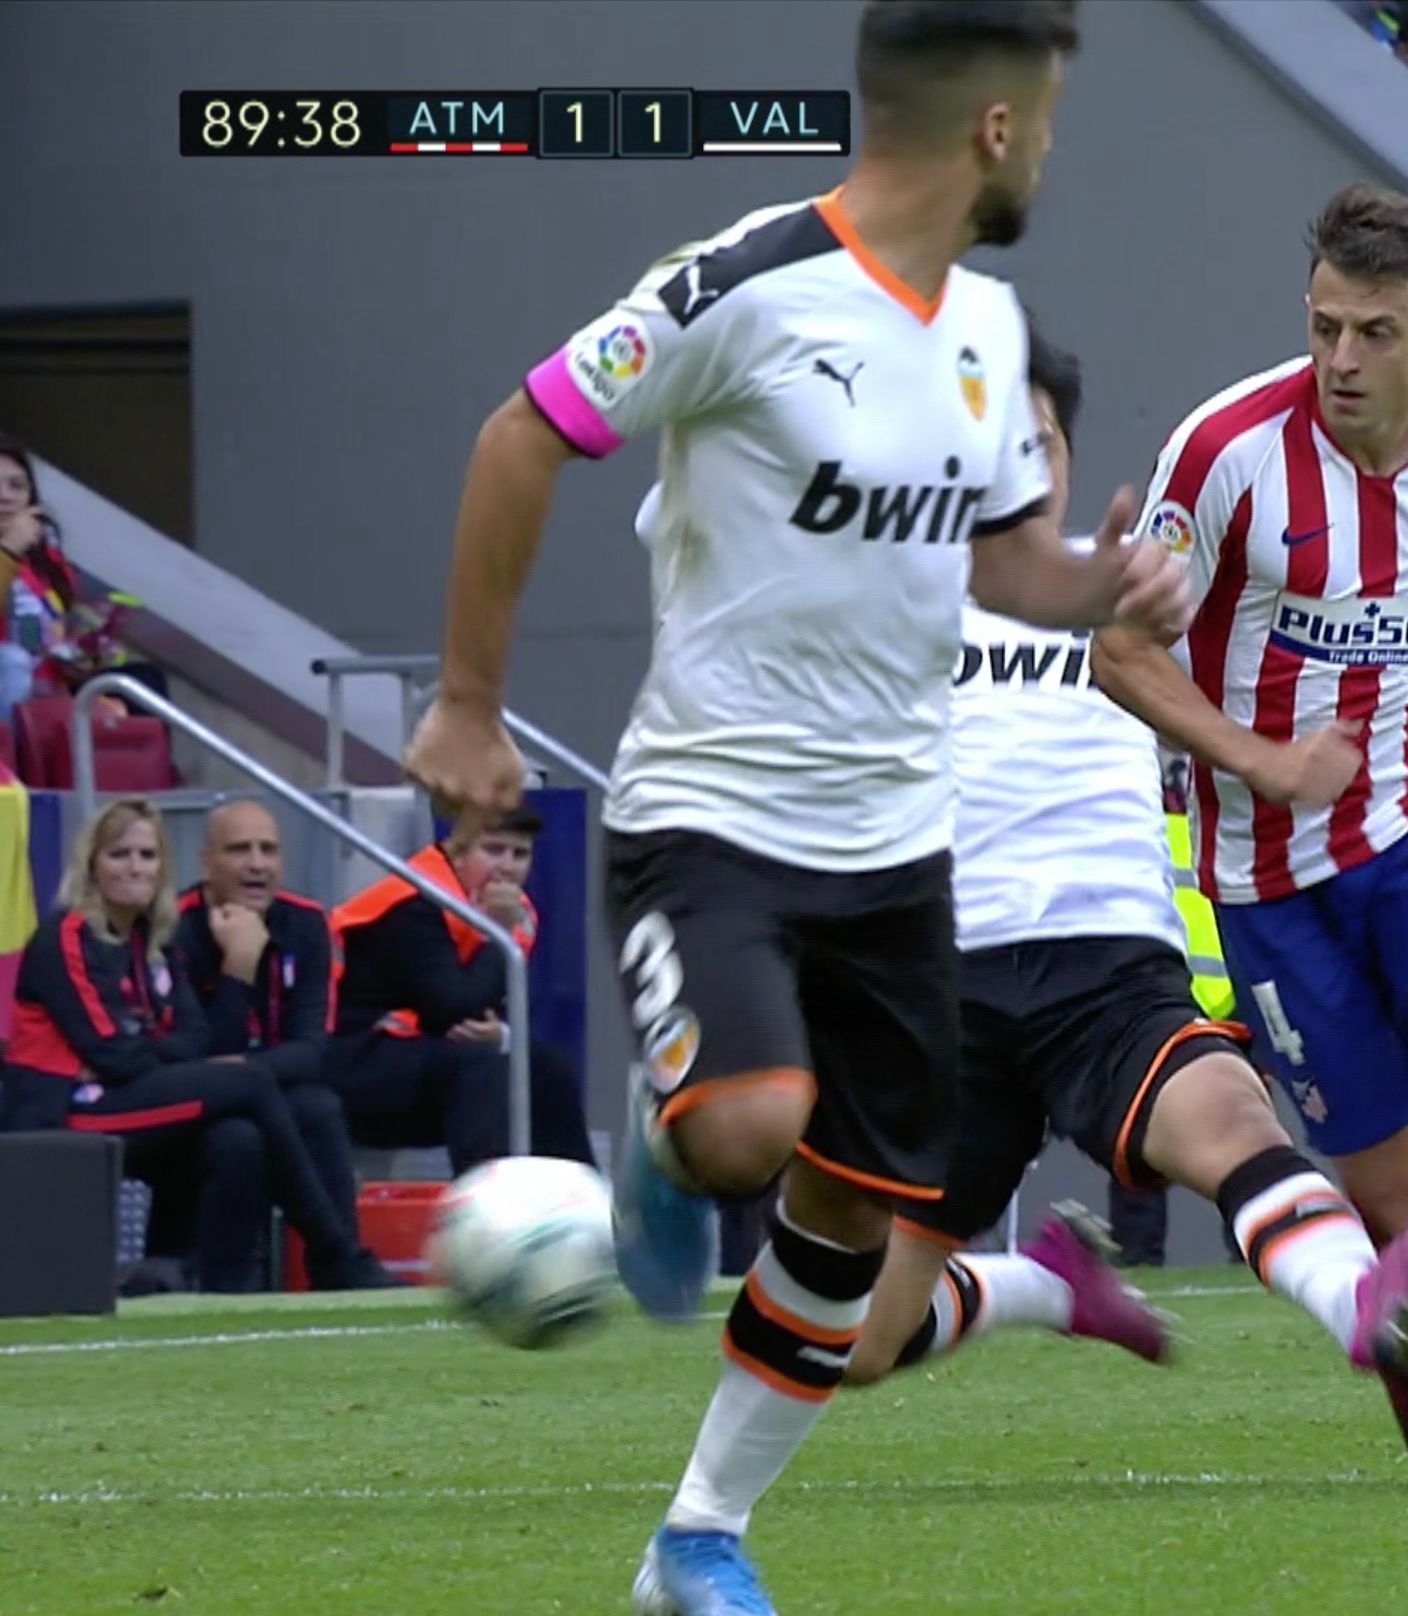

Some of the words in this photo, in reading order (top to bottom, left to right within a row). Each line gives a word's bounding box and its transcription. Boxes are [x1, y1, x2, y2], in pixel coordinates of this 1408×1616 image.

[1329, 650, 1365, 664] Trade
[618, 910, 684, 1031] 3
[1250, 978, 1306, 1067] 4
